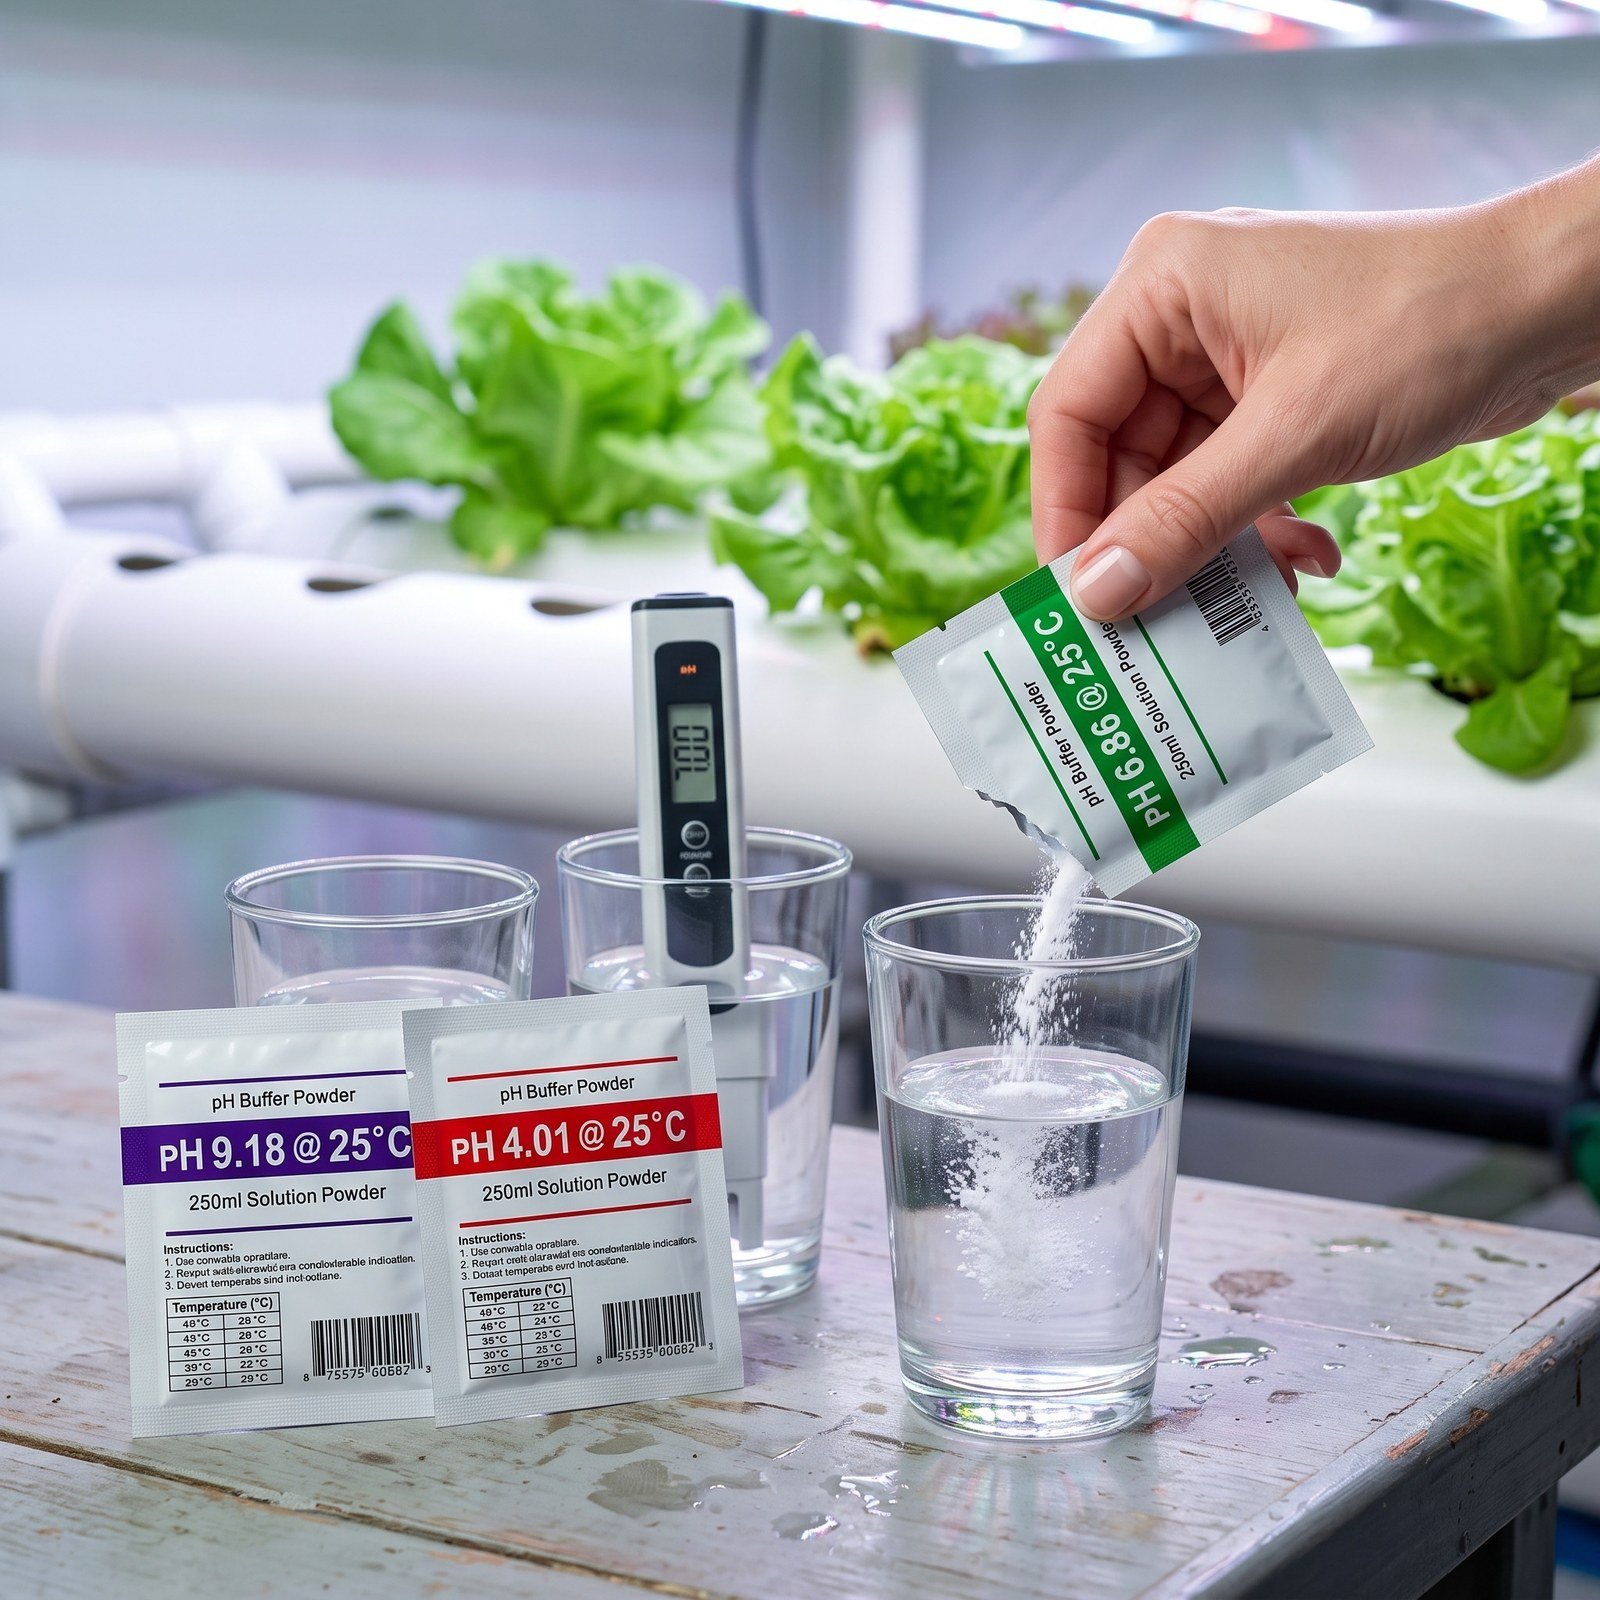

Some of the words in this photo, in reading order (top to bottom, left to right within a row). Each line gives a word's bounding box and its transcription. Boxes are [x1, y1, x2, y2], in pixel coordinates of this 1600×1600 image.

[1034, 611, 1094, 684] 25°C
[1024, 681, 1062, 737] Powder
[1076, 683, 1107, 711] @
[1130, 672, 1170, 734] Solution
[1091, 714, 1145, 781] 6.86
[1161, 737, 1195, 781] 250ml
[1055, 738, 1088, 785] Buffer
[1079, 785, 1105, 808] pH
[1128, 781, 1170, 827] PH
[212, 1093, 235, 1113] pH
[240, 1091, 289, 1108] Buffer
[294, 1088, 356, 1105] Powder
[500, 1086, 522, 1105] pH
[527, 1082, 573, 1100] Buffer
[577, 1075, 635, 1095] Powder
[159, 1138, 203, 1172] PH
[212, 1132, 285, 1170] 9.18
[293, 1132, 321, 1163] @
[329, 1125, 411, 1163] 25°C
[451, 1129, 494, 1165] PH
[502, 1122, 569, 1159] 4.01
[579, 1119, 605, 1151] @
[611, 1110, 686, 1148] 25°C
[189, 1193, 242, 1211] 250ml
[247, 1189, 317, 1207] Solution
[322, 1185, 387, 1203] Powder
[482, 1182, 533, 1202] 250ml
[537, 1175, 603, 1197] Solution
[608, 1169, 667, 1188] Powder
[163, 1243, 234, 1255] Instructions:
[459, 1231, 526, 1246] Instructions:
[165, 1258, 173, 1267] 1.
[460, 1250, 468, 1258] 1.
[471, 1247, 489, 1257] Use
[461, 1261, 469, 1269] 2.
[165, 1270, 173, 1279] 2.
[165, 1282, 173, 1290] 3.
[211, 1276, 261, 1289] temperabs
[461, 1272, 470, 1281] 3.
[504, 1262, 554, 1277] temperabs
[172, 1301, 247, 1314] Temperature
[250, 1296, 274, 1311] (°C)
[470, 1287, 542, 1303] Temperature
[545, 1283, 566, 1297] (°C)
[596, 1356, 603, 1364] 8
[617, 1349, 653, 1362] 55535
[303, 1373, 310, 1381] 8
[326, 1368, 365, 1380] 75575
[425, 1366, 431, 1374] 3
